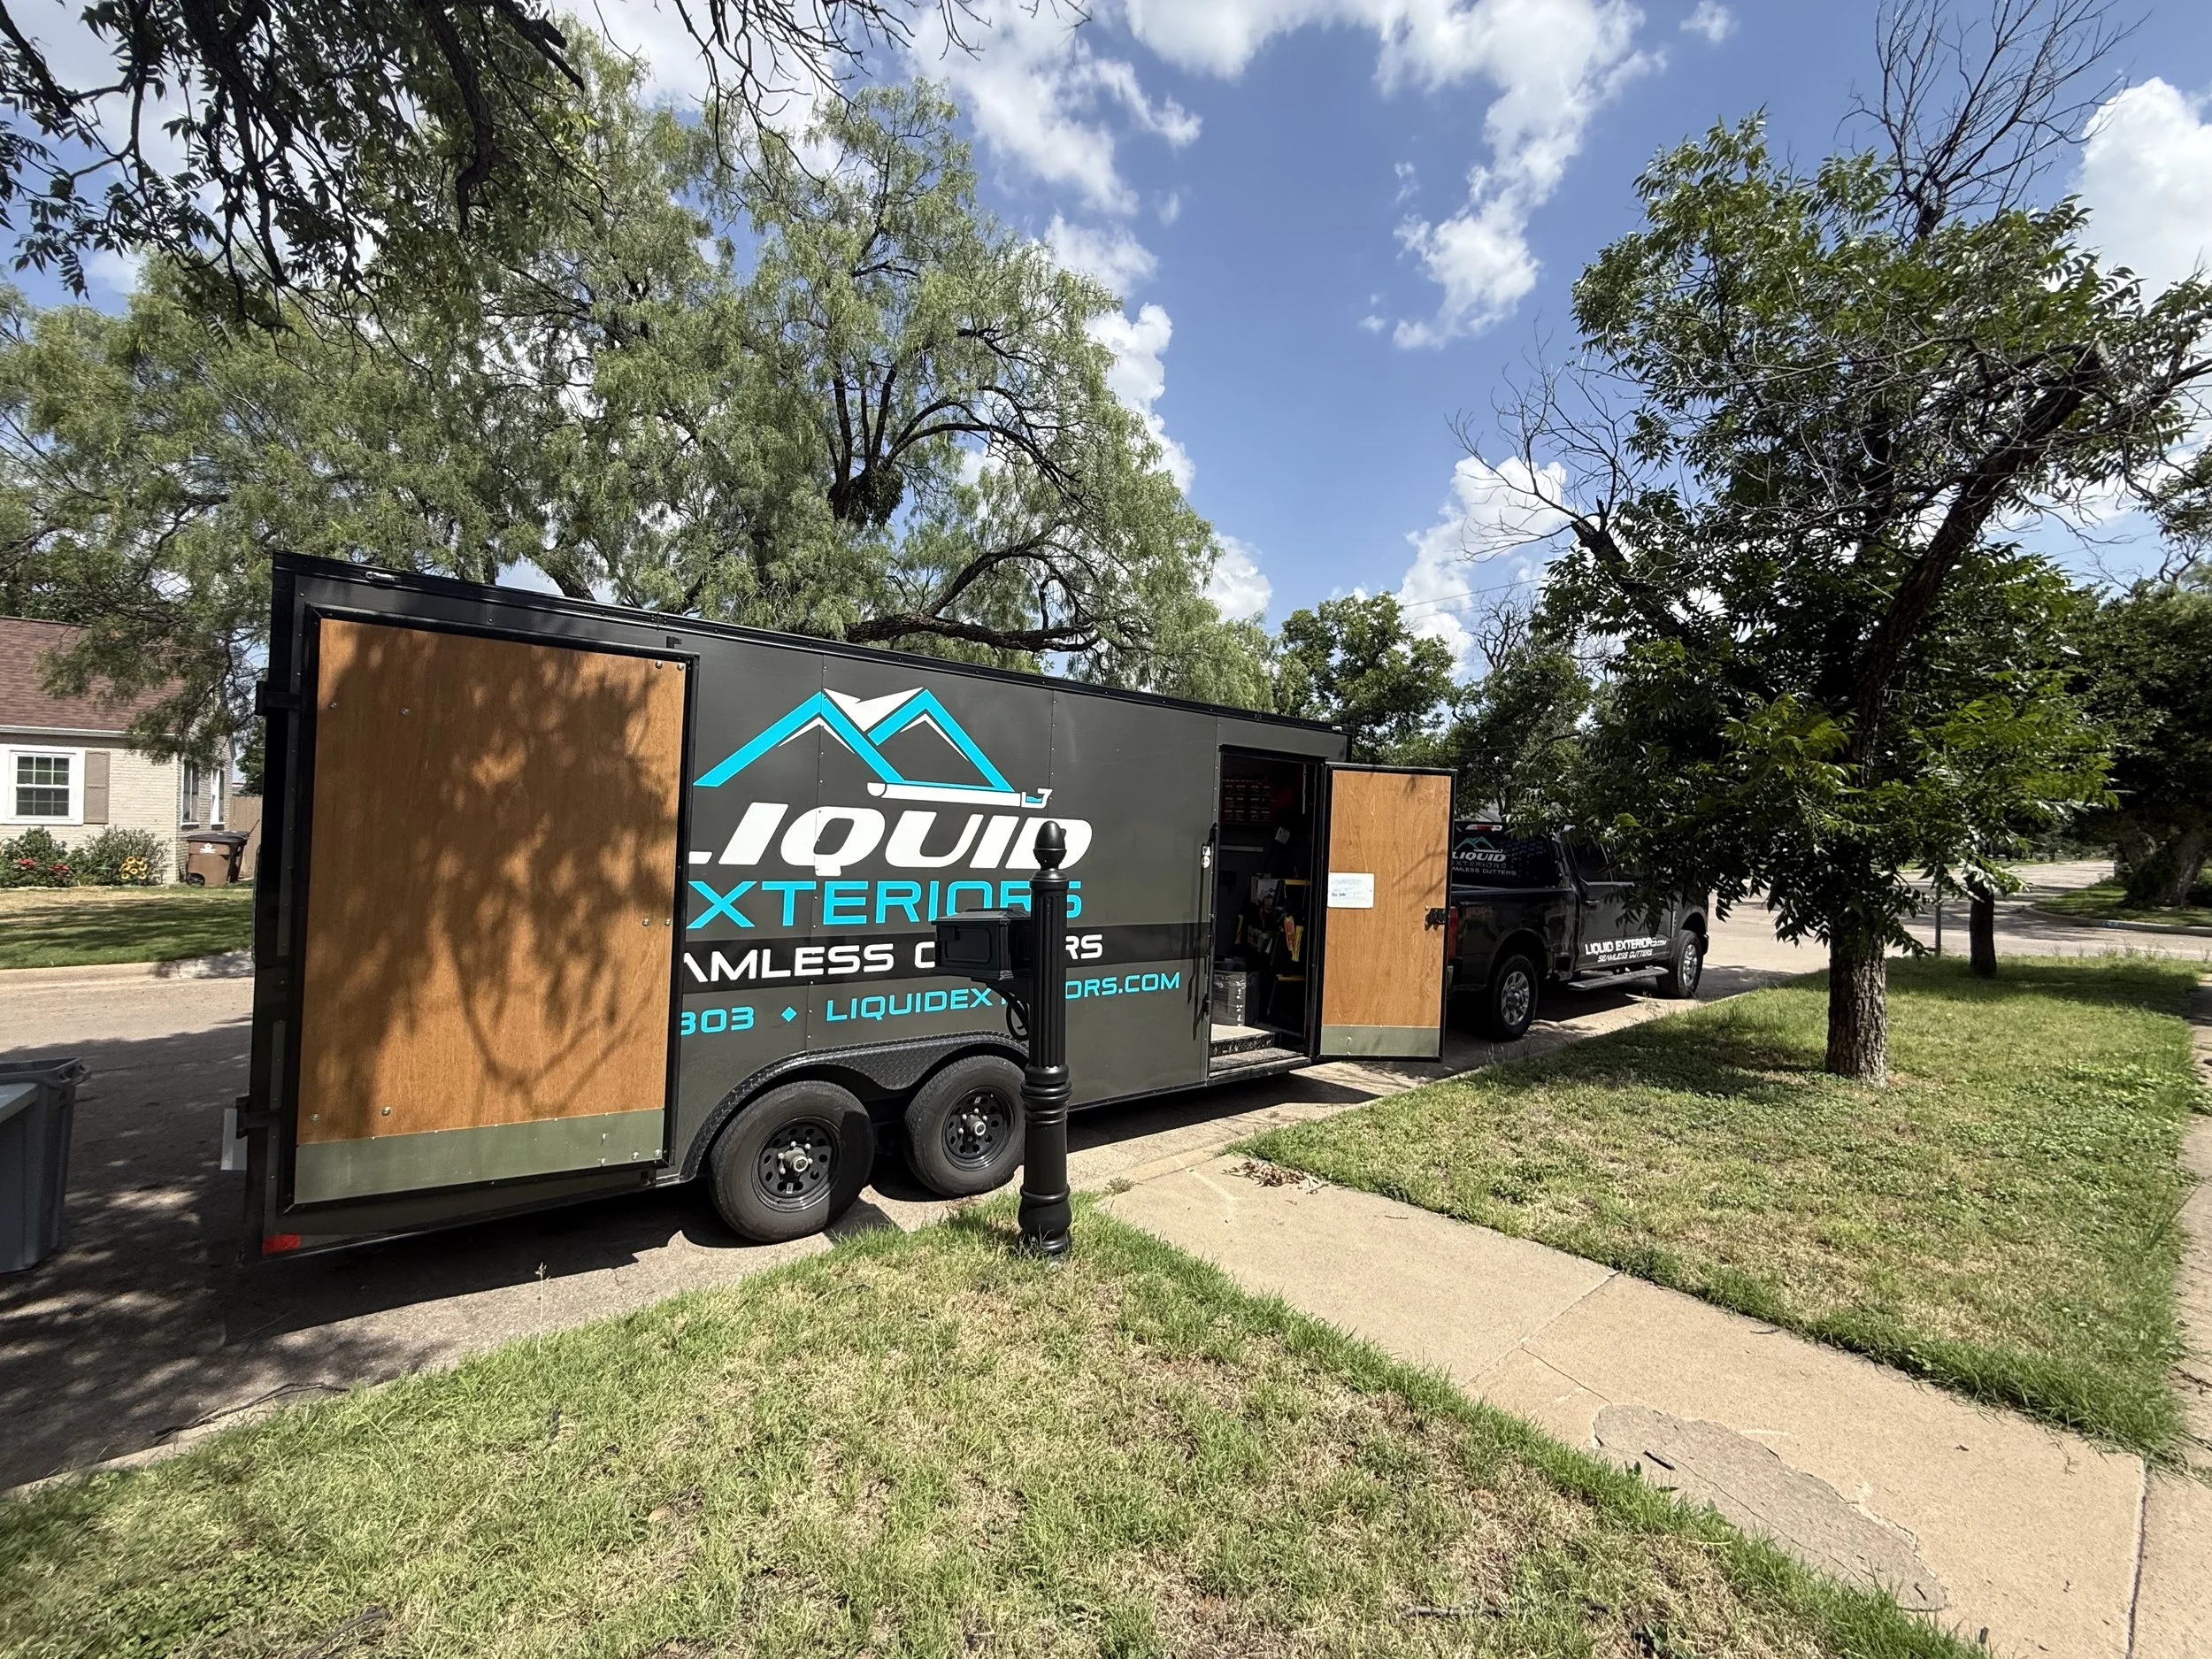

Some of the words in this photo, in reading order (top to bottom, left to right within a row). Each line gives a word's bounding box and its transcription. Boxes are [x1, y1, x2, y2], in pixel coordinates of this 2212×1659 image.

[1452, 851, 1506, 862] LIQUID
[687, 880, 1081, 929] XTERIOR
[1585, 941, 1614, 955] LIQUID
[1598, 952, 1628, 963] SEAMLESS
[1629, 949, 1653, 958] GUTTERS
[683, 943, 894, 982] AMLESS
[826, 972, 1180, 1021] LIQUIDEXORS.COM
